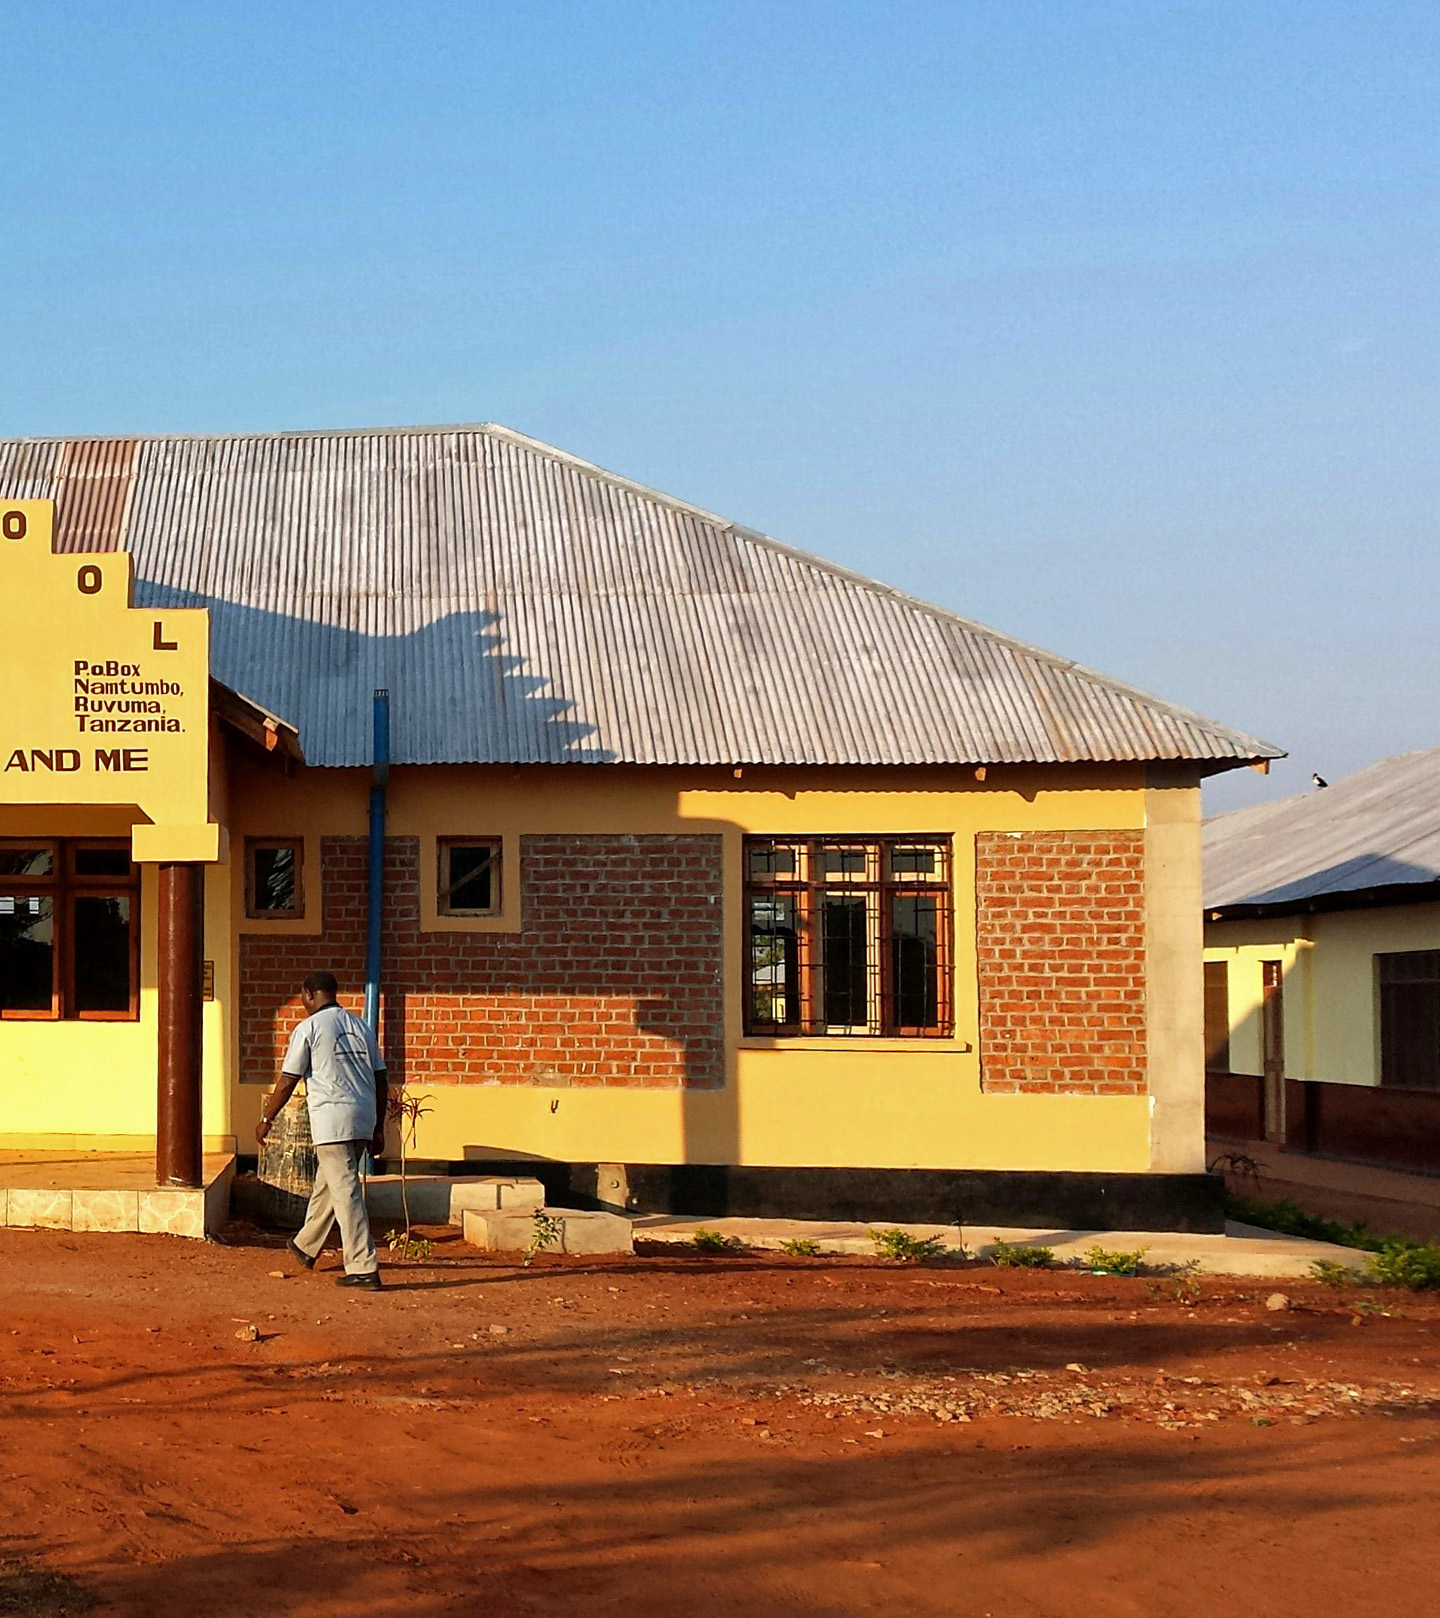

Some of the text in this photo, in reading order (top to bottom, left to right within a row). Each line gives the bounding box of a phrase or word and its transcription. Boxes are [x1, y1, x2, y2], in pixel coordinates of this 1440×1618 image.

[2, 510, 28, 540] O
[77, 564, 103, 595] O
[152, 621, 179, 651] L
[73, 678, 185, 697] Namtumbo,
[73, 696, 167, 715] Ruvuma,
[74, 714, 187, 733] Tanzania.
[3, 749, 81, 773] AND
[94, 748, 149, 773] ME
